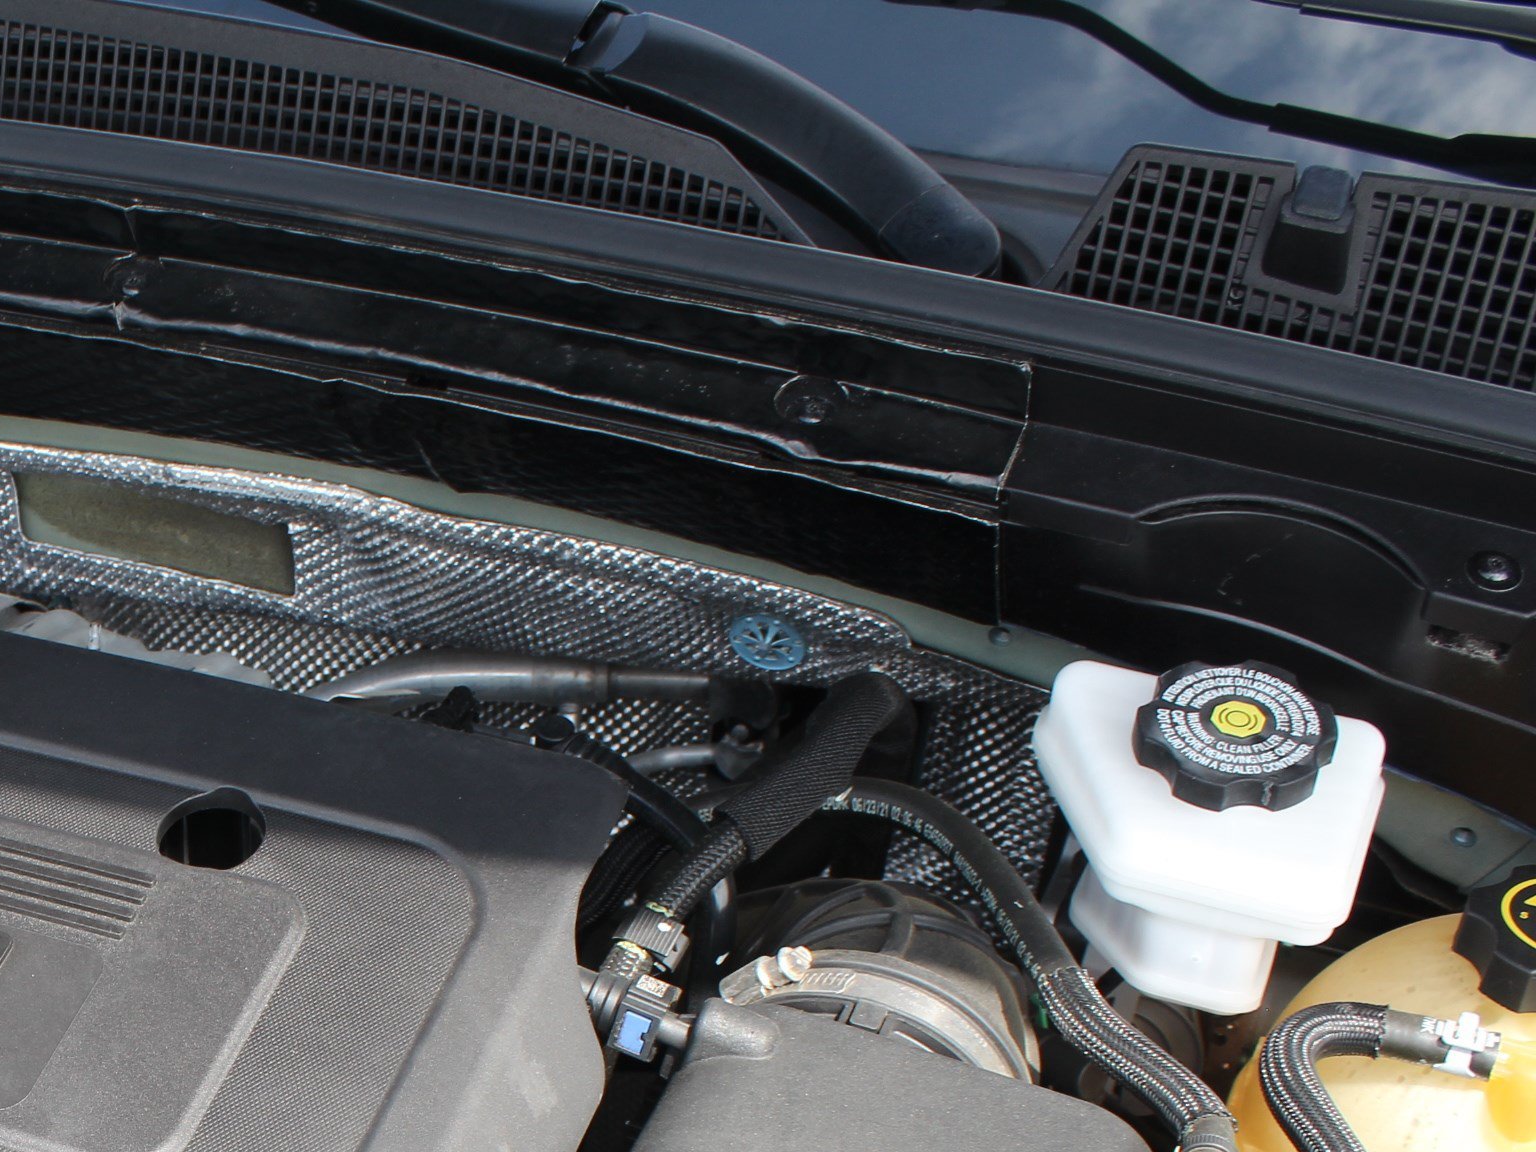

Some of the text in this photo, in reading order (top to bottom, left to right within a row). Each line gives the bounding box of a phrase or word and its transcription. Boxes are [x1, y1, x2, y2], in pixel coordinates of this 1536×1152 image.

[1243, 669, 1254, 677] LE
[1161, 726, 1186, 751] FLUID
[1181, 748, 1211, 767] FROM
[1209, 760, 1219, 770] A
[1218, 763, 1263, 775] SEALED
[1171, 709, 1299, 765] CAP BEFORE REMOVING USE ONLY
[1216, 740, 1252, 754] CLEAN
[1252, 734, 1284, 754] FILLER
